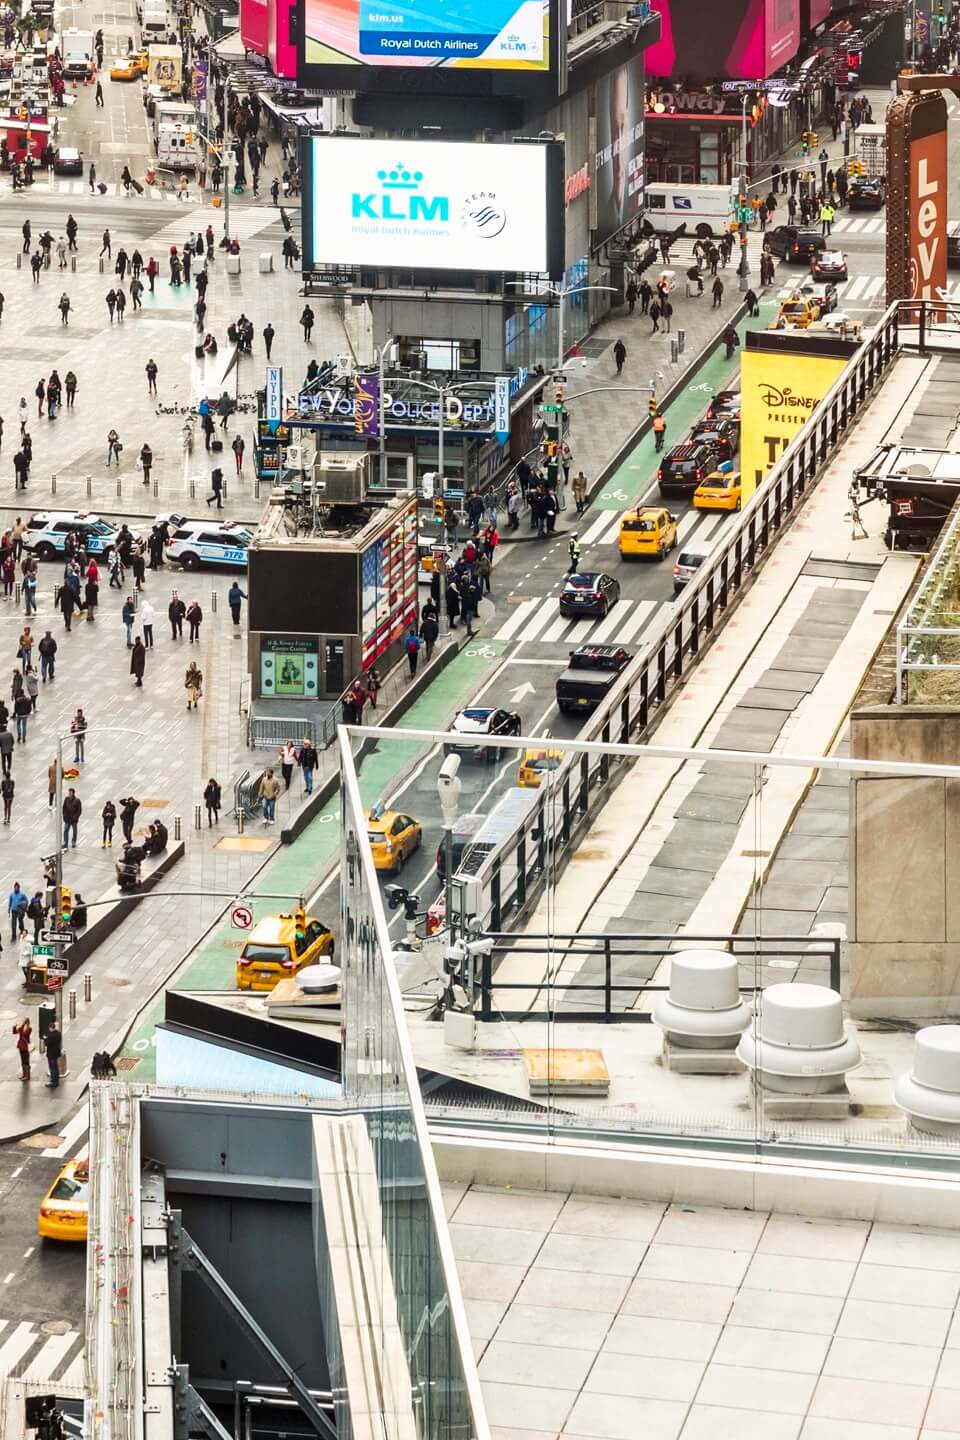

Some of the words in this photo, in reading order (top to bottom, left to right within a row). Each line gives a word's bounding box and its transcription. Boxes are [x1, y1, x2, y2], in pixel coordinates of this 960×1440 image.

[380, 38, 412, 50] Royal
[415, 38, 442, 49] Dutch
[444, 39, 479, 50] Airlines
[499, 41, 527, 51] KLM
[351, 193, 449, 222] KLM
[282, 391, 321, 418] NEW
[223, 550, 244, 560] NYPD
